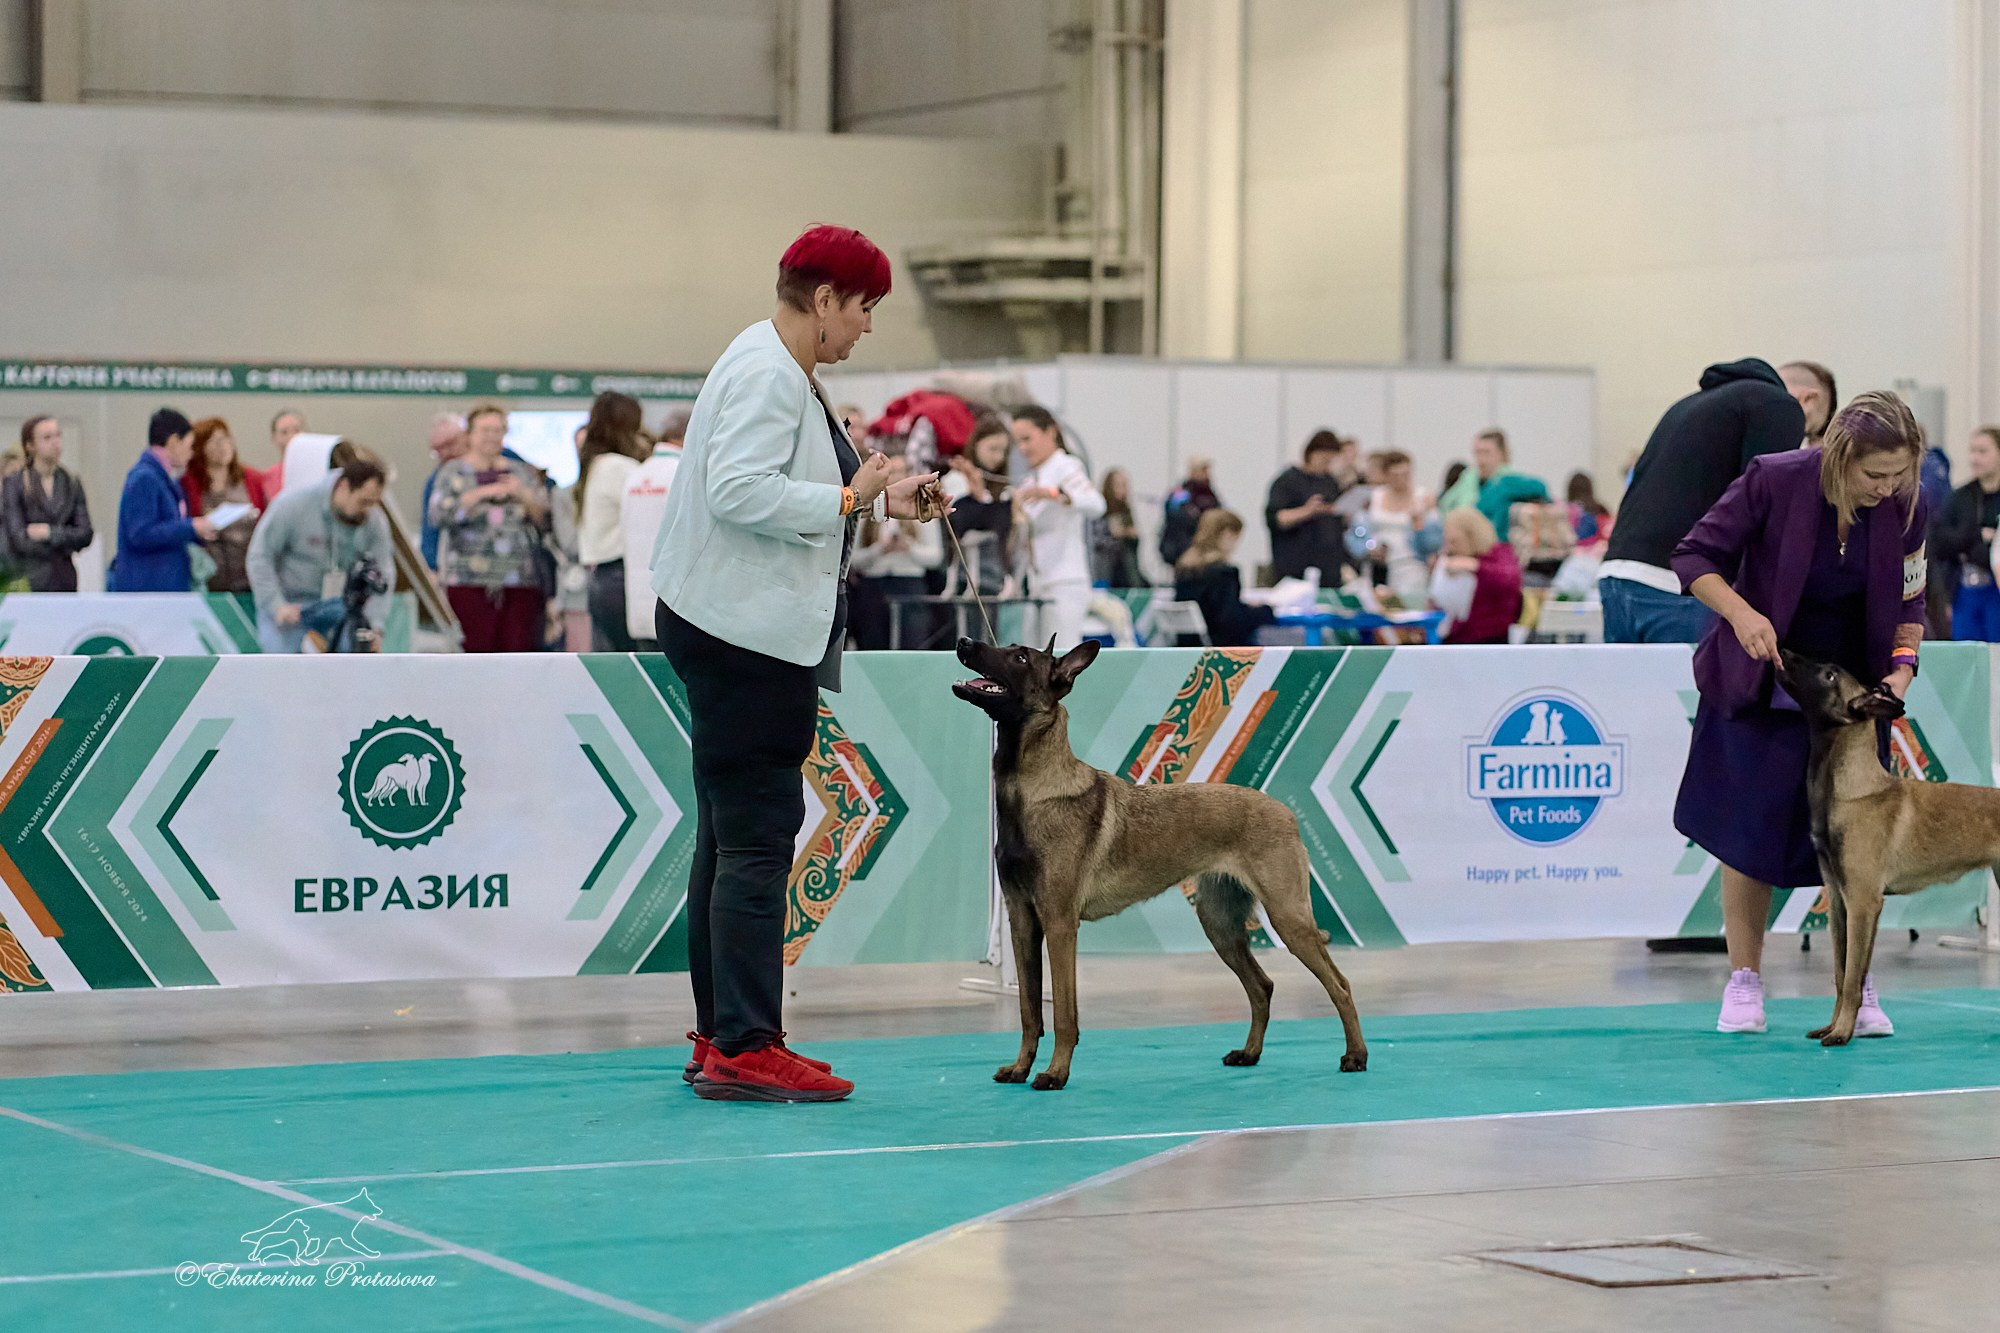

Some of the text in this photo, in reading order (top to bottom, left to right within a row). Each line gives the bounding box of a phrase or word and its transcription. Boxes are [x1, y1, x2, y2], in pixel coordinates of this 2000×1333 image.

[43, 780, 63, 807] КУБОК
[59, 730, 97, 781] ПРЕЗИДЕНТА
[93, 713, 107, 732] РКФ
[1479, 753, 1612, 790] Farmina
[1509, 805, 1582, 824] Pet Foods
[97, 855, 130, 897] НОЯБРЯ
[127, 898, 148, 922] 2024
[294, 873, 509, 913] ЕВРАЗИЯ
[1466, 864, 1623, 884] Happy pet. Happy you.
